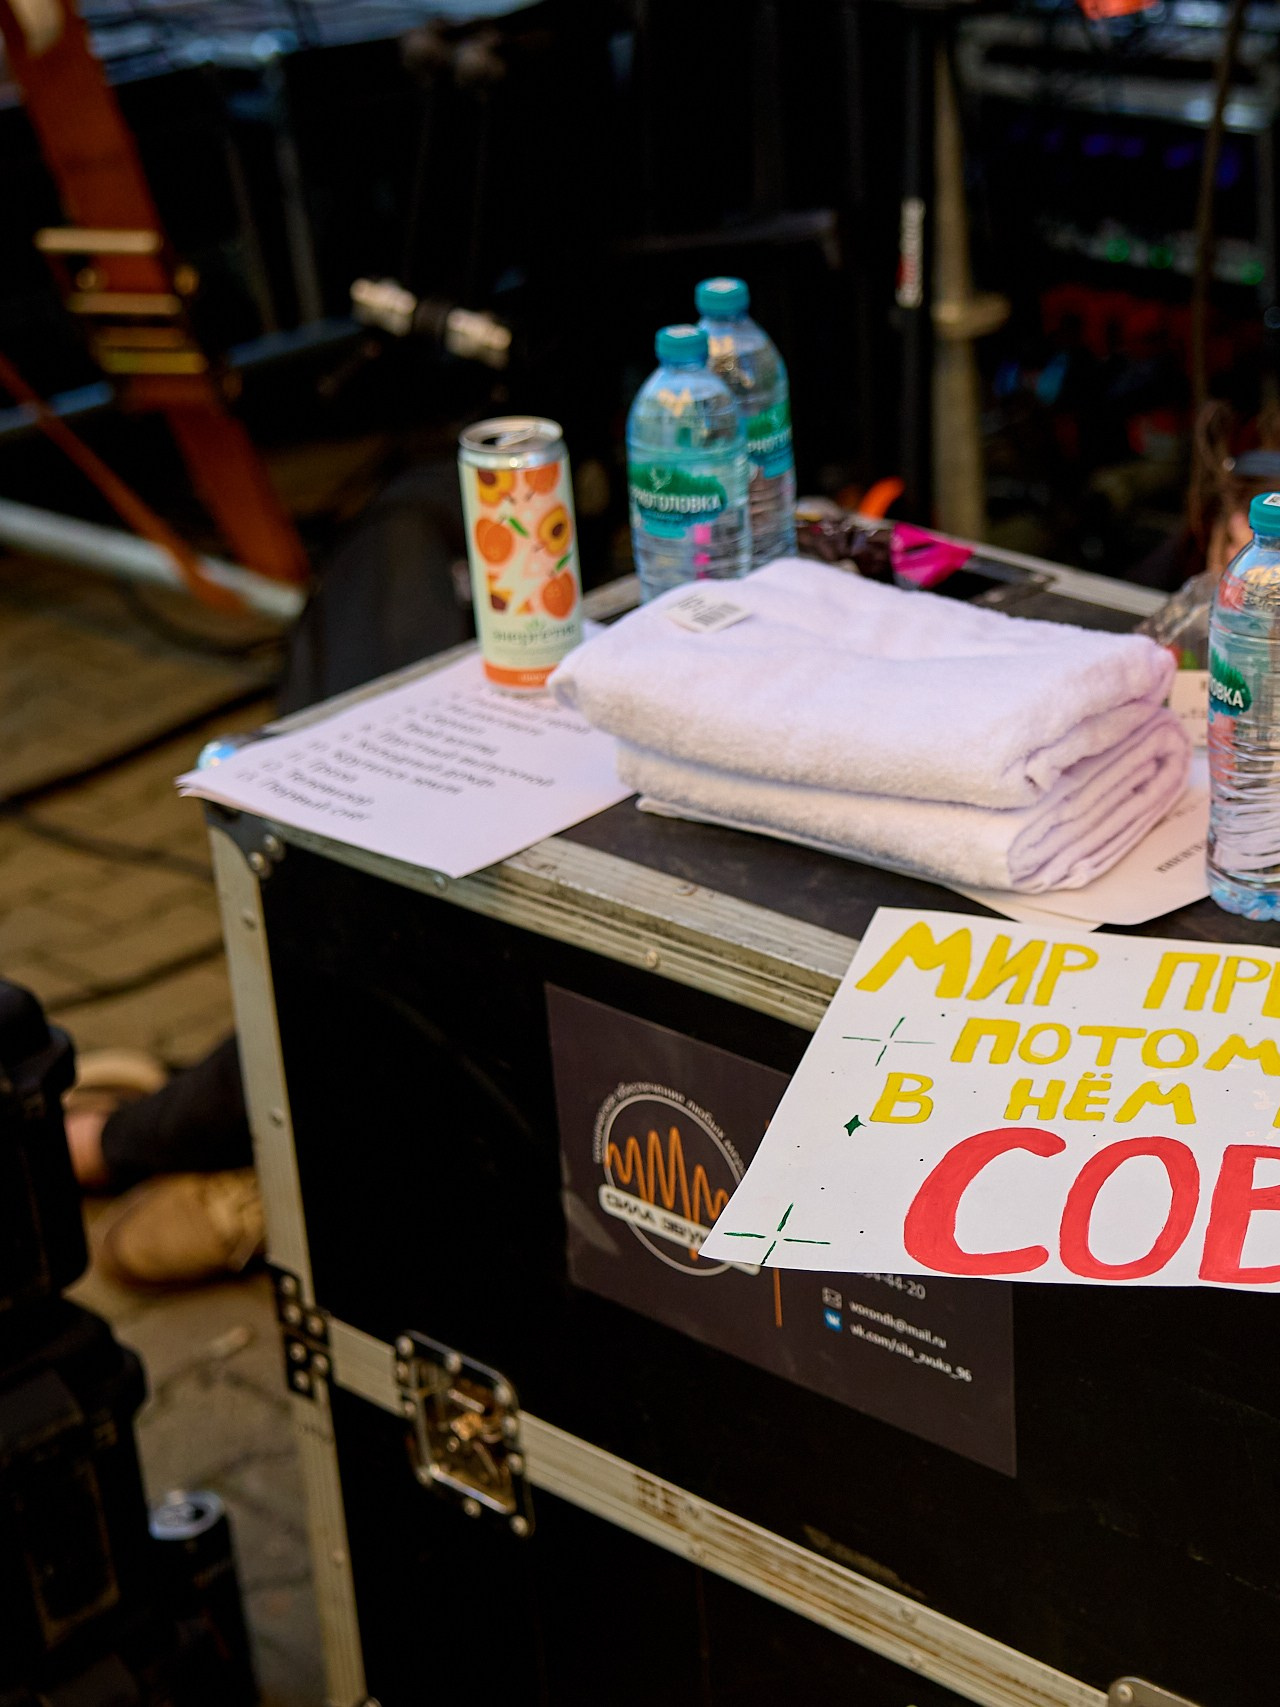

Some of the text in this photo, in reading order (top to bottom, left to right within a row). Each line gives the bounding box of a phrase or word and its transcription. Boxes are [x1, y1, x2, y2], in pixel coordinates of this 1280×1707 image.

[855, 921, 1099, 1007] МИР
[869, 1072, 935, 1125] В
[1003, 1071, 1197, 1125] НЁМ
